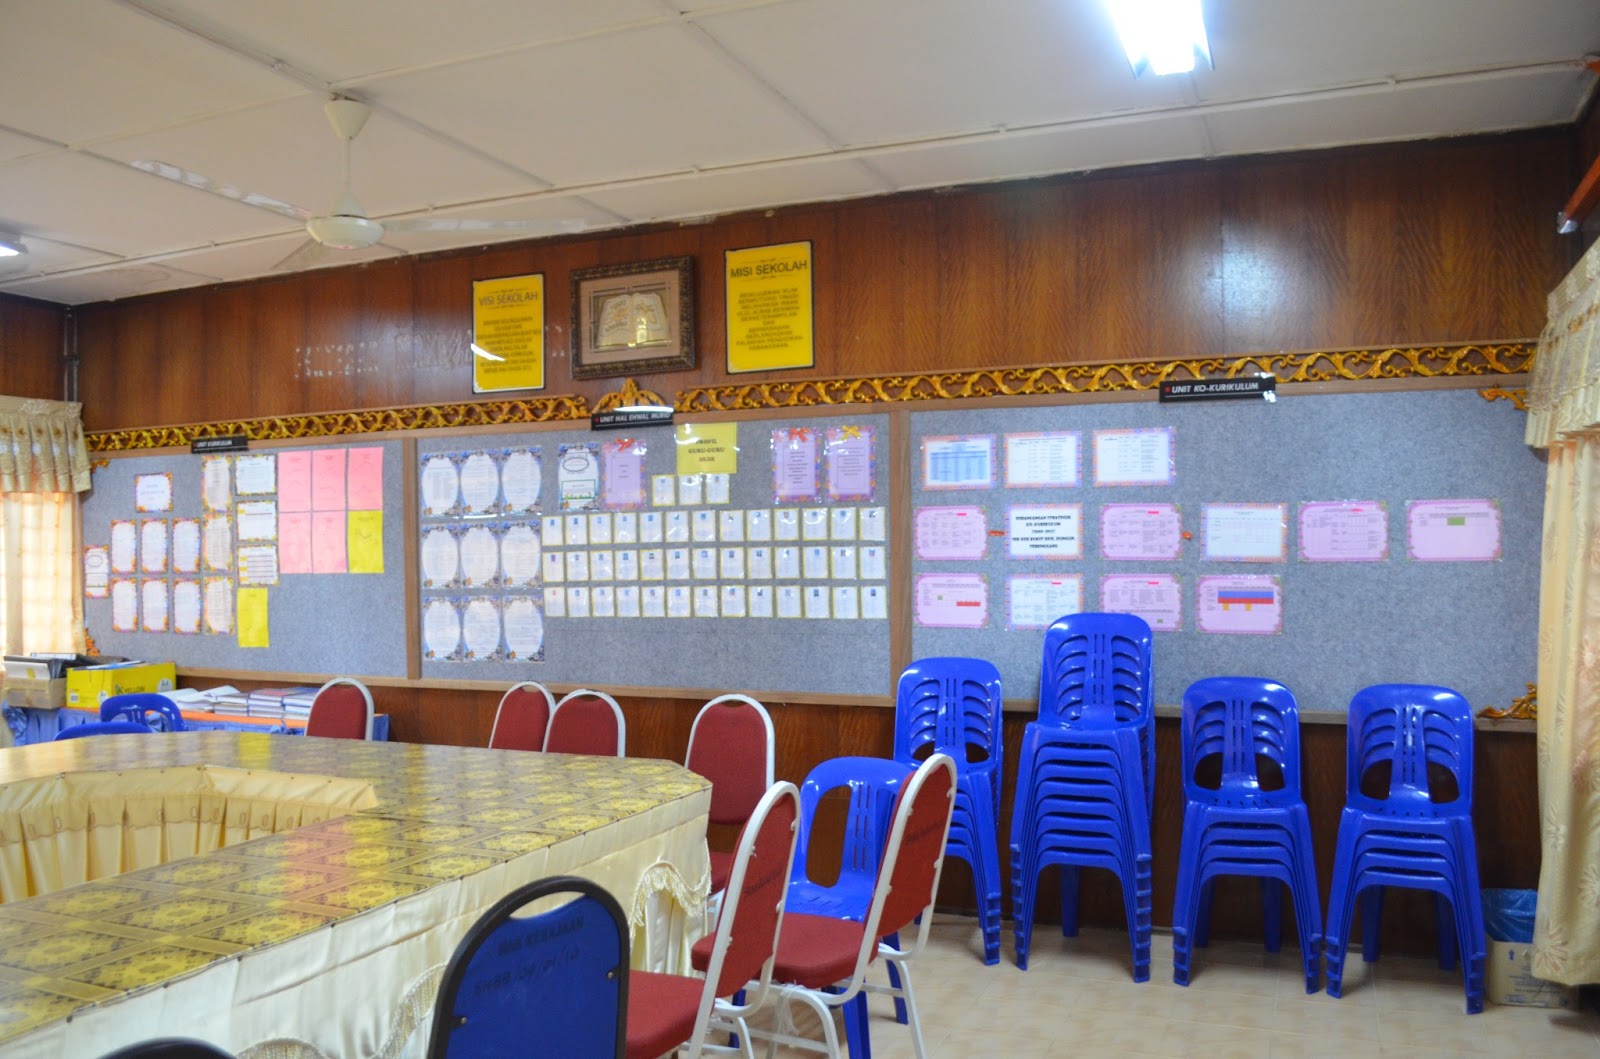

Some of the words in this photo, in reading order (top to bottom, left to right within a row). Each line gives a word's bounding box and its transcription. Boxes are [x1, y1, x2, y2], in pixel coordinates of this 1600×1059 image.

[730, 266, 753, 278] MISI
[755, 260, 808, 276] SEKOLAH
[478, 295, 494, 306] VISI
[496, 291, 538, 304] SEKOLAH
[1171, 385, 1192, 394] UNIT
[1193, 382, 1259, 392] KO-KURIKULUM
[600, 416, 614, 424] UNIT
[628, 413, 650, 421] EHWAL
[124, 686, 146, 694] YELLOW
